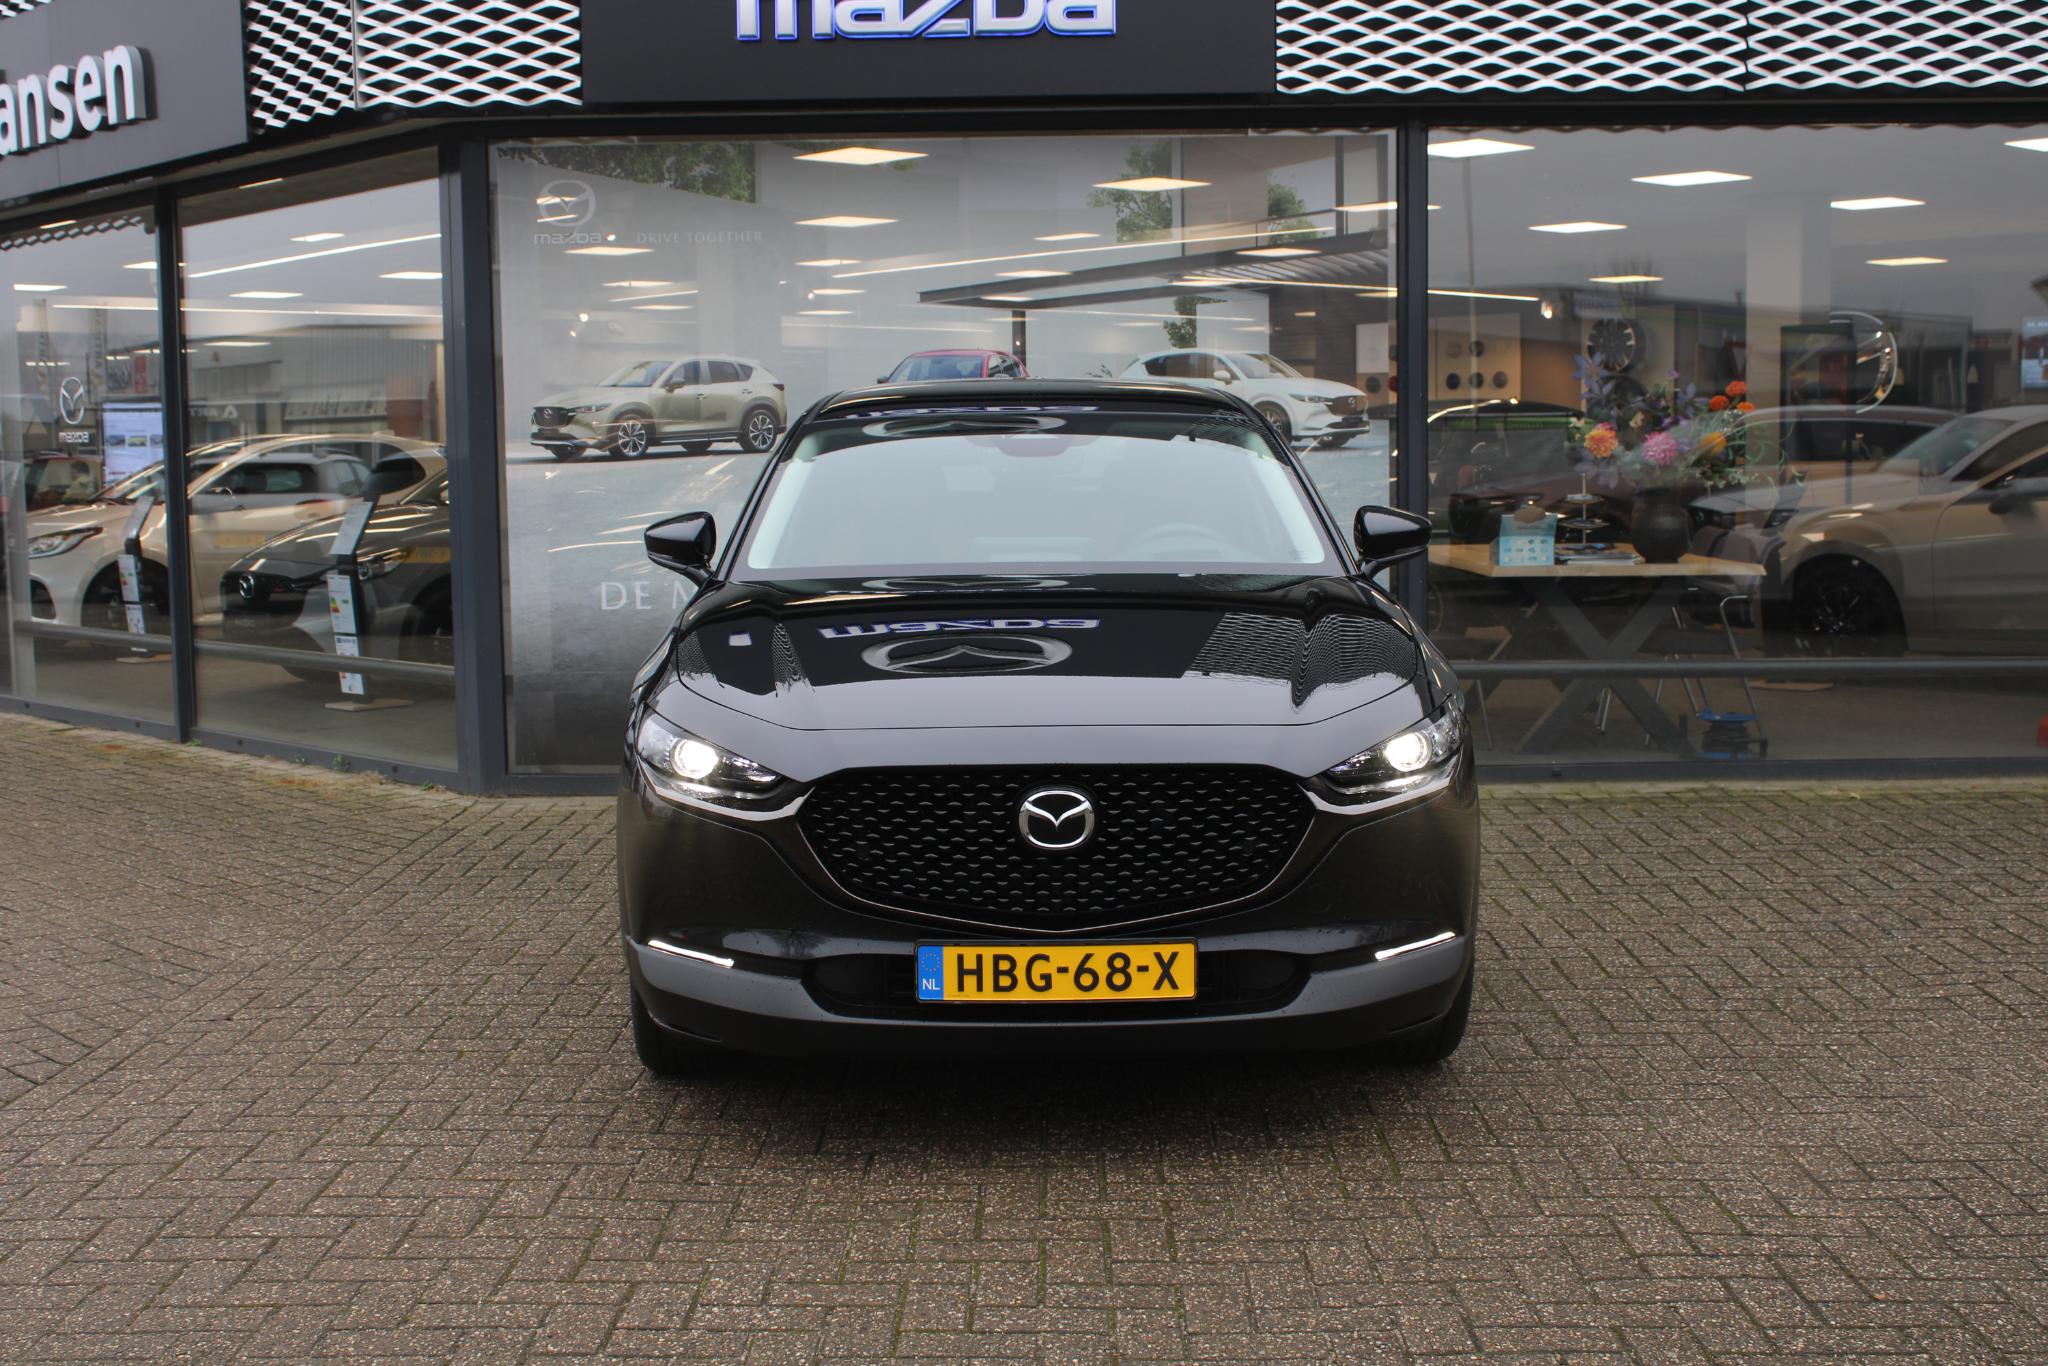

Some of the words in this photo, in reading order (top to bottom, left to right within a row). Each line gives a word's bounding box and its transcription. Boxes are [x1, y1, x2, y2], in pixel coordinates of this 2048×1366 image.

[636, 231, 680, 244] DRIVE
[687, 230, 763, 244] TOGETHER
[601, 581, 652, 611] DE
[955, 951, 1180, 993] HBG-68-X
[921, 977, 941, 991] NL
